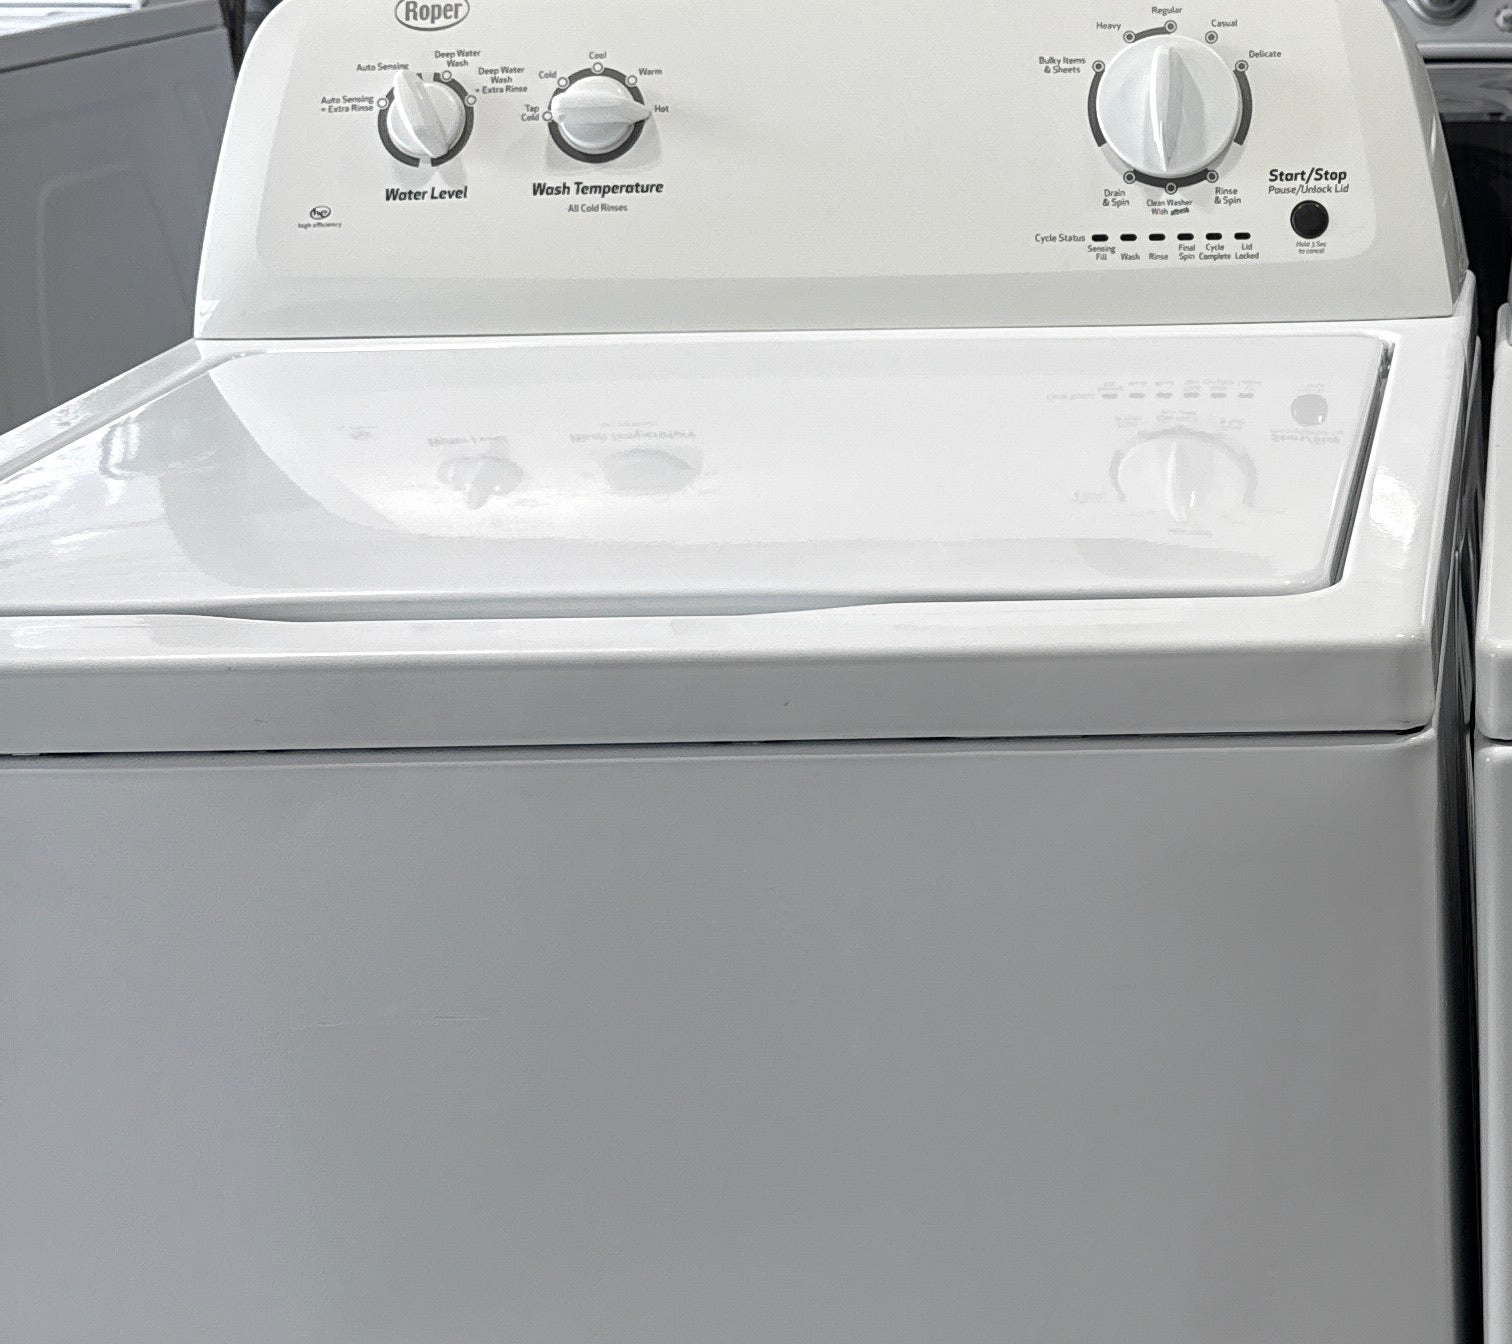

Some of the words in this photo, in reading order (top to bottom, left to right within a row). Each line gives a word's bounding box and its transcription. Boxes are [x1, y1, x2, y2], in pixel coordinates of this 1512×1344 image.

[405, 0, 463, 24] Roper
[1151, 6, 1183, 16] Regular
[1096, 21, 1121, 32] Heavy
[1211, 19, 1238, 27] Casual
[434, 50, 455, 60] Deep
[456, 49, 481, 58] Water
[1249, 49, 1282, 58] Delicate
[447, 59, 468, 67] Wash
[1039, 56, 1062, 66] Bulky
[1063, 56, 1086, 64] Items
[356, 63, 376, 71] Auto
[478, 67, 499, 76] Deep
[501, 66, 525, 74] Water
[1053, 65, 1081, 74] Sheets
[538, 71, 557, 79] Cold
[639, 68, 662, 76] Warm
[491, 76, 512, 84] Wash
[482, 86, 503, 94] Extra
[505, 85, 528, 93] Rinse
[321, 96, 341, 105] Auto
[342, 95, 374, 105] Sensing
[328, 105, 350, 113] Extra
[351, 104, 374, 112] Rinse
[525, 104, 539, 113] Tap
[655, 105, 669, 113] Hot
[521, 113, 539, 121] Cold
[1268, 168, 1347, 184] Start/Stop
[385, 188, 428, 202] Water
[430, 186, 468, 200] Level
[532, 182, 570, 196] Wash
[574, 181, 664, 198] Temperature
[1104, 189, 1126, 198] Drain
[1215, 187, 1238, 196] Rinse
[1268, 184, 1332, 195] Pause/Unlock
[1334, 184, 1350, 194] Lid
[1111, 197, 1130, 208] Spin
[1223, 195, 1242, 206] Spin
[568, 204, 580, 213] All
[581, 204, 599, 212] Cold
[601, 203, 628, 212] Rinses
[1035, 233, 1057, 244] Cycle
[1058, 233, 1086, 242] Status
[1087, 244, 1116, 254] Sensing
[1178, 243, 1196, 252] Final
[1205, 243, 1225, 252] Cycle
[1241, 242, 1253, 251] Lid
[1120, 252, 1141, 261] Wash
[1149, 252, 1168, 261] Rinse
[1178, 252, 1196, 262] Spin
[1198, 251, 1231, 262] Complete
[1234, 251, 1260, 261] Locked
